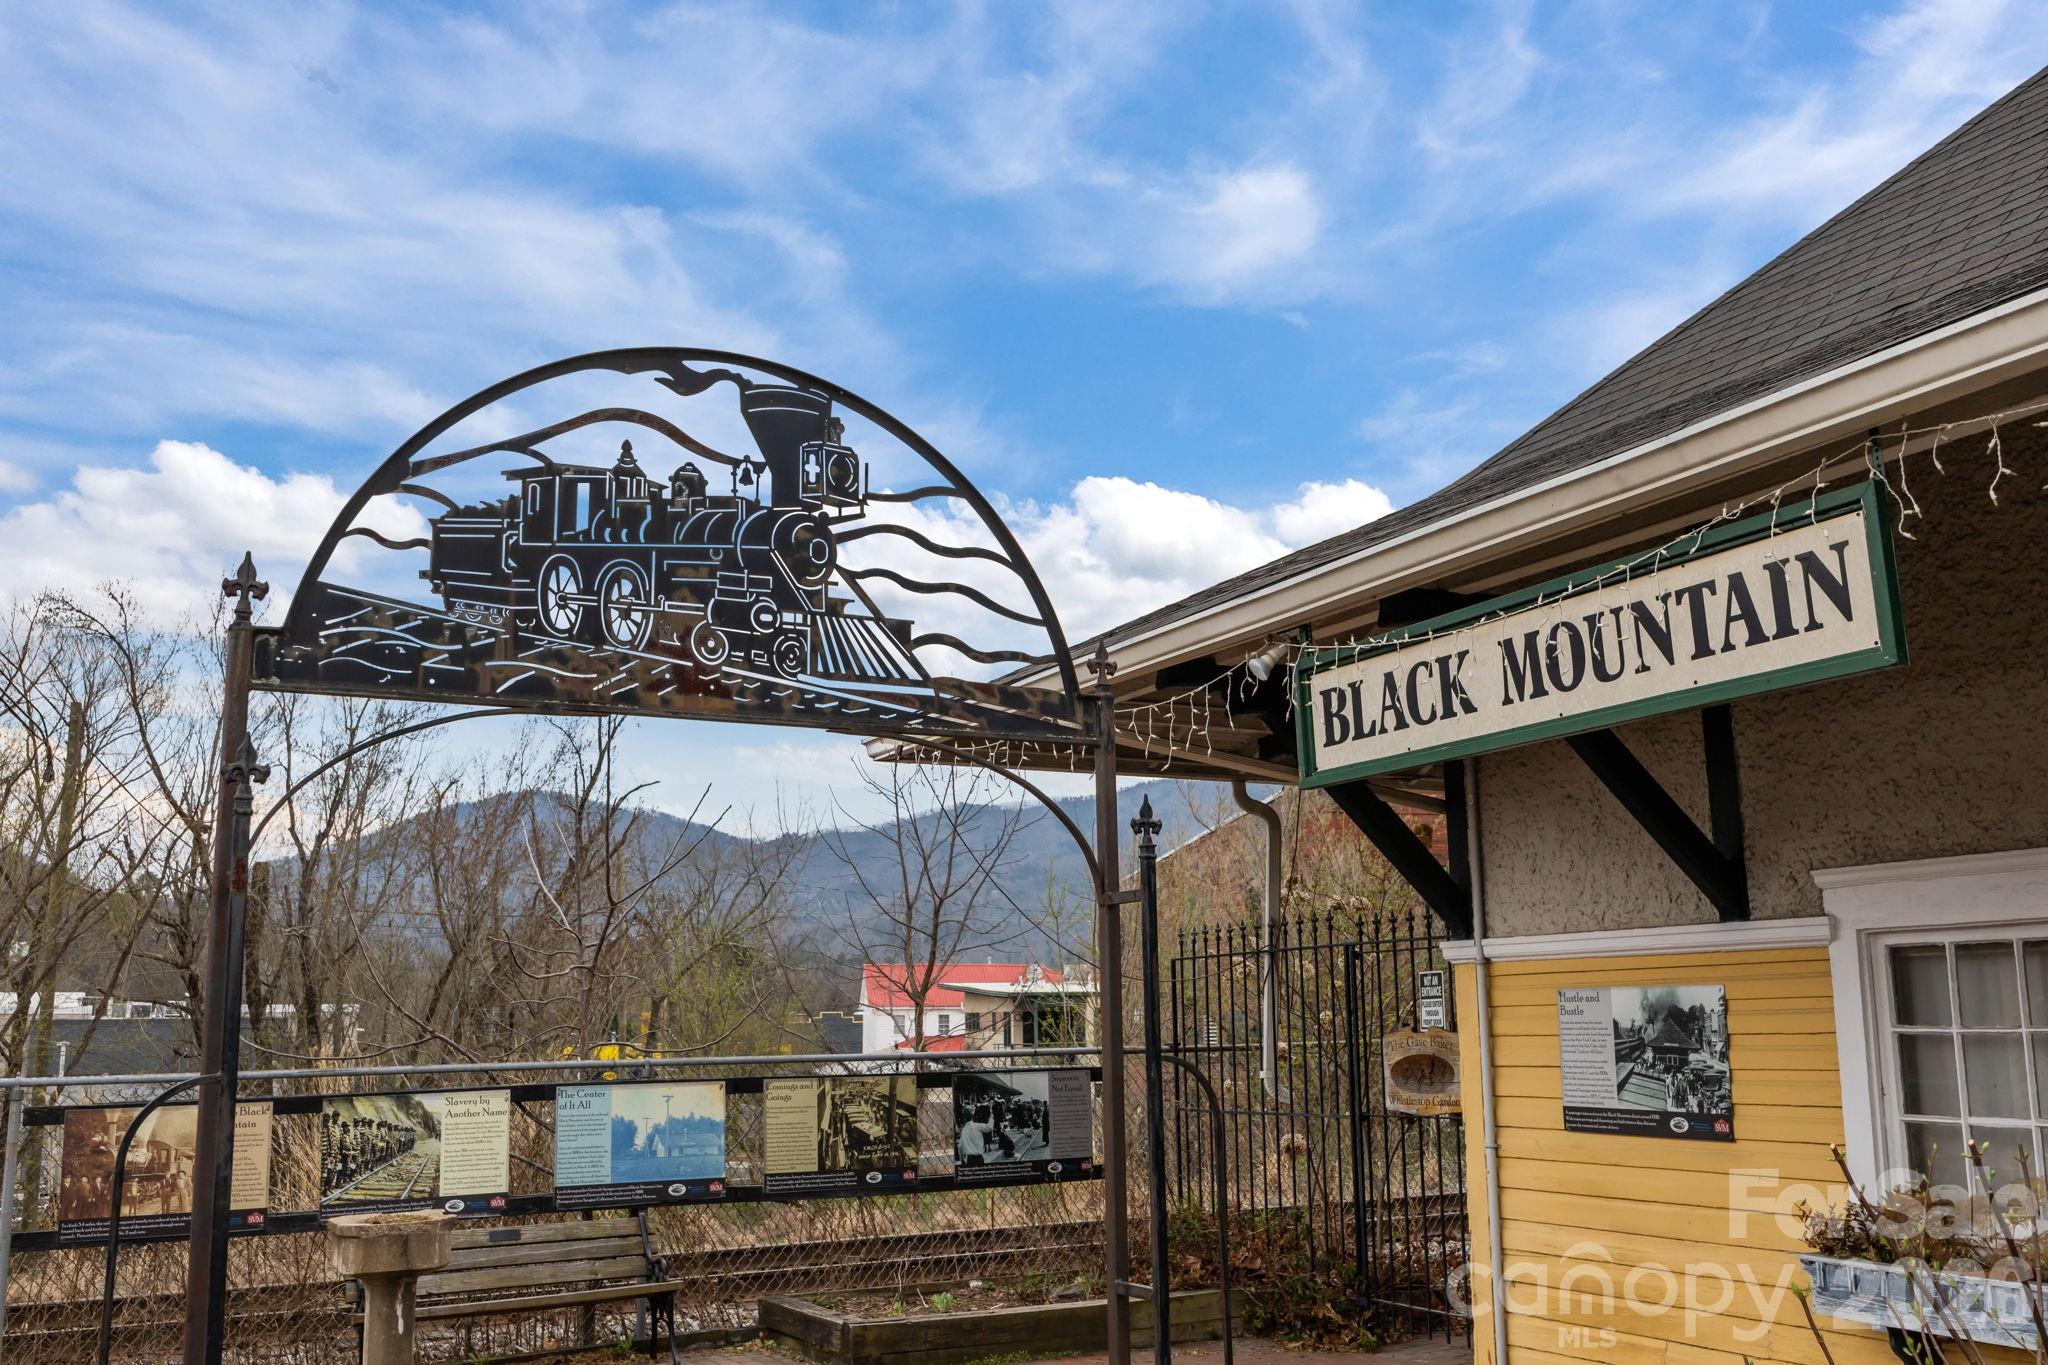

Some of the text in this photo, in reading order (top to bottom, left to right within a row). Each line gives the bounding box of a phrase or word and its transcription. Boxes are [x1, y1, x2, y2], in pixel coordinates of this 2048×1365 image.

[1319, 539, 1855, 748] BLACK MOUNTAIN
[1421, 986, 1442, 997] ENTRANCE
[1559, 991, 1600, 1003] Hustle and
[1560, 1004, 1584, 1016] Bustle
[1388, 1039, 1405, 1052] The
[800, 1080, 813, 1090] and
[559, 1088, 606, 1099] The Center
[765, 1092, 792, 1103] Goings
[445, 1095, 490, 1107] Slavery by
[559, 1100, 591, 1110] of It All
[240, 1105, 267, 1117] Black
[445, 1107, 508, 1118] Another Name
[1714, 1123, 1730, 1133] SVM
[247, 1215, 264, 1224] SVM
